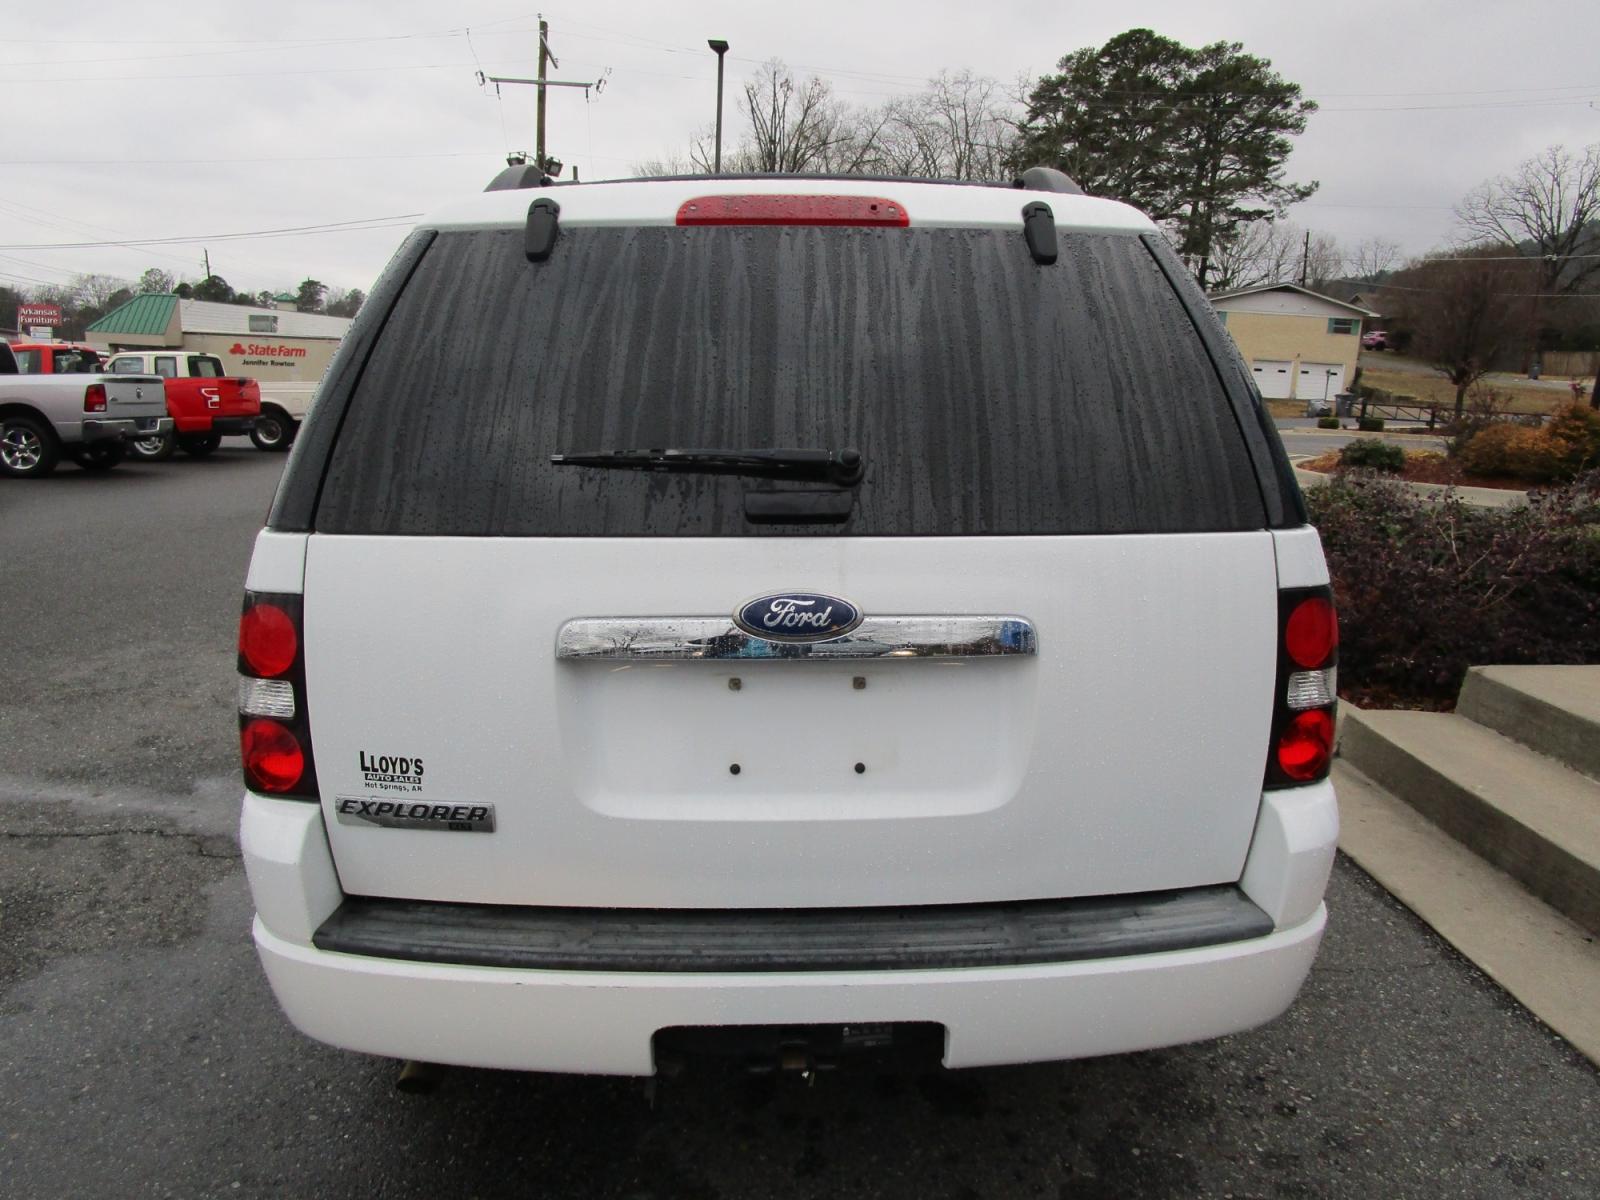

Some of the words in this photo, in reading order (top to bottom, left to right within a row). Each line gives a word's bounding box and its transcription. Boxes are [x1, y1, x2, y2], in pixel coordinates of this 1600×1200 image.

[20, 307, 58, 316] Arkansas
[20, 315, 58, 324] Furniture
[763, 598, 833, 627] Ford
[360, 750, 424, 776] LLOYD'S
[393, 776, 420, 784] SALES
[339, 799, 488, 821] EXPLORER
